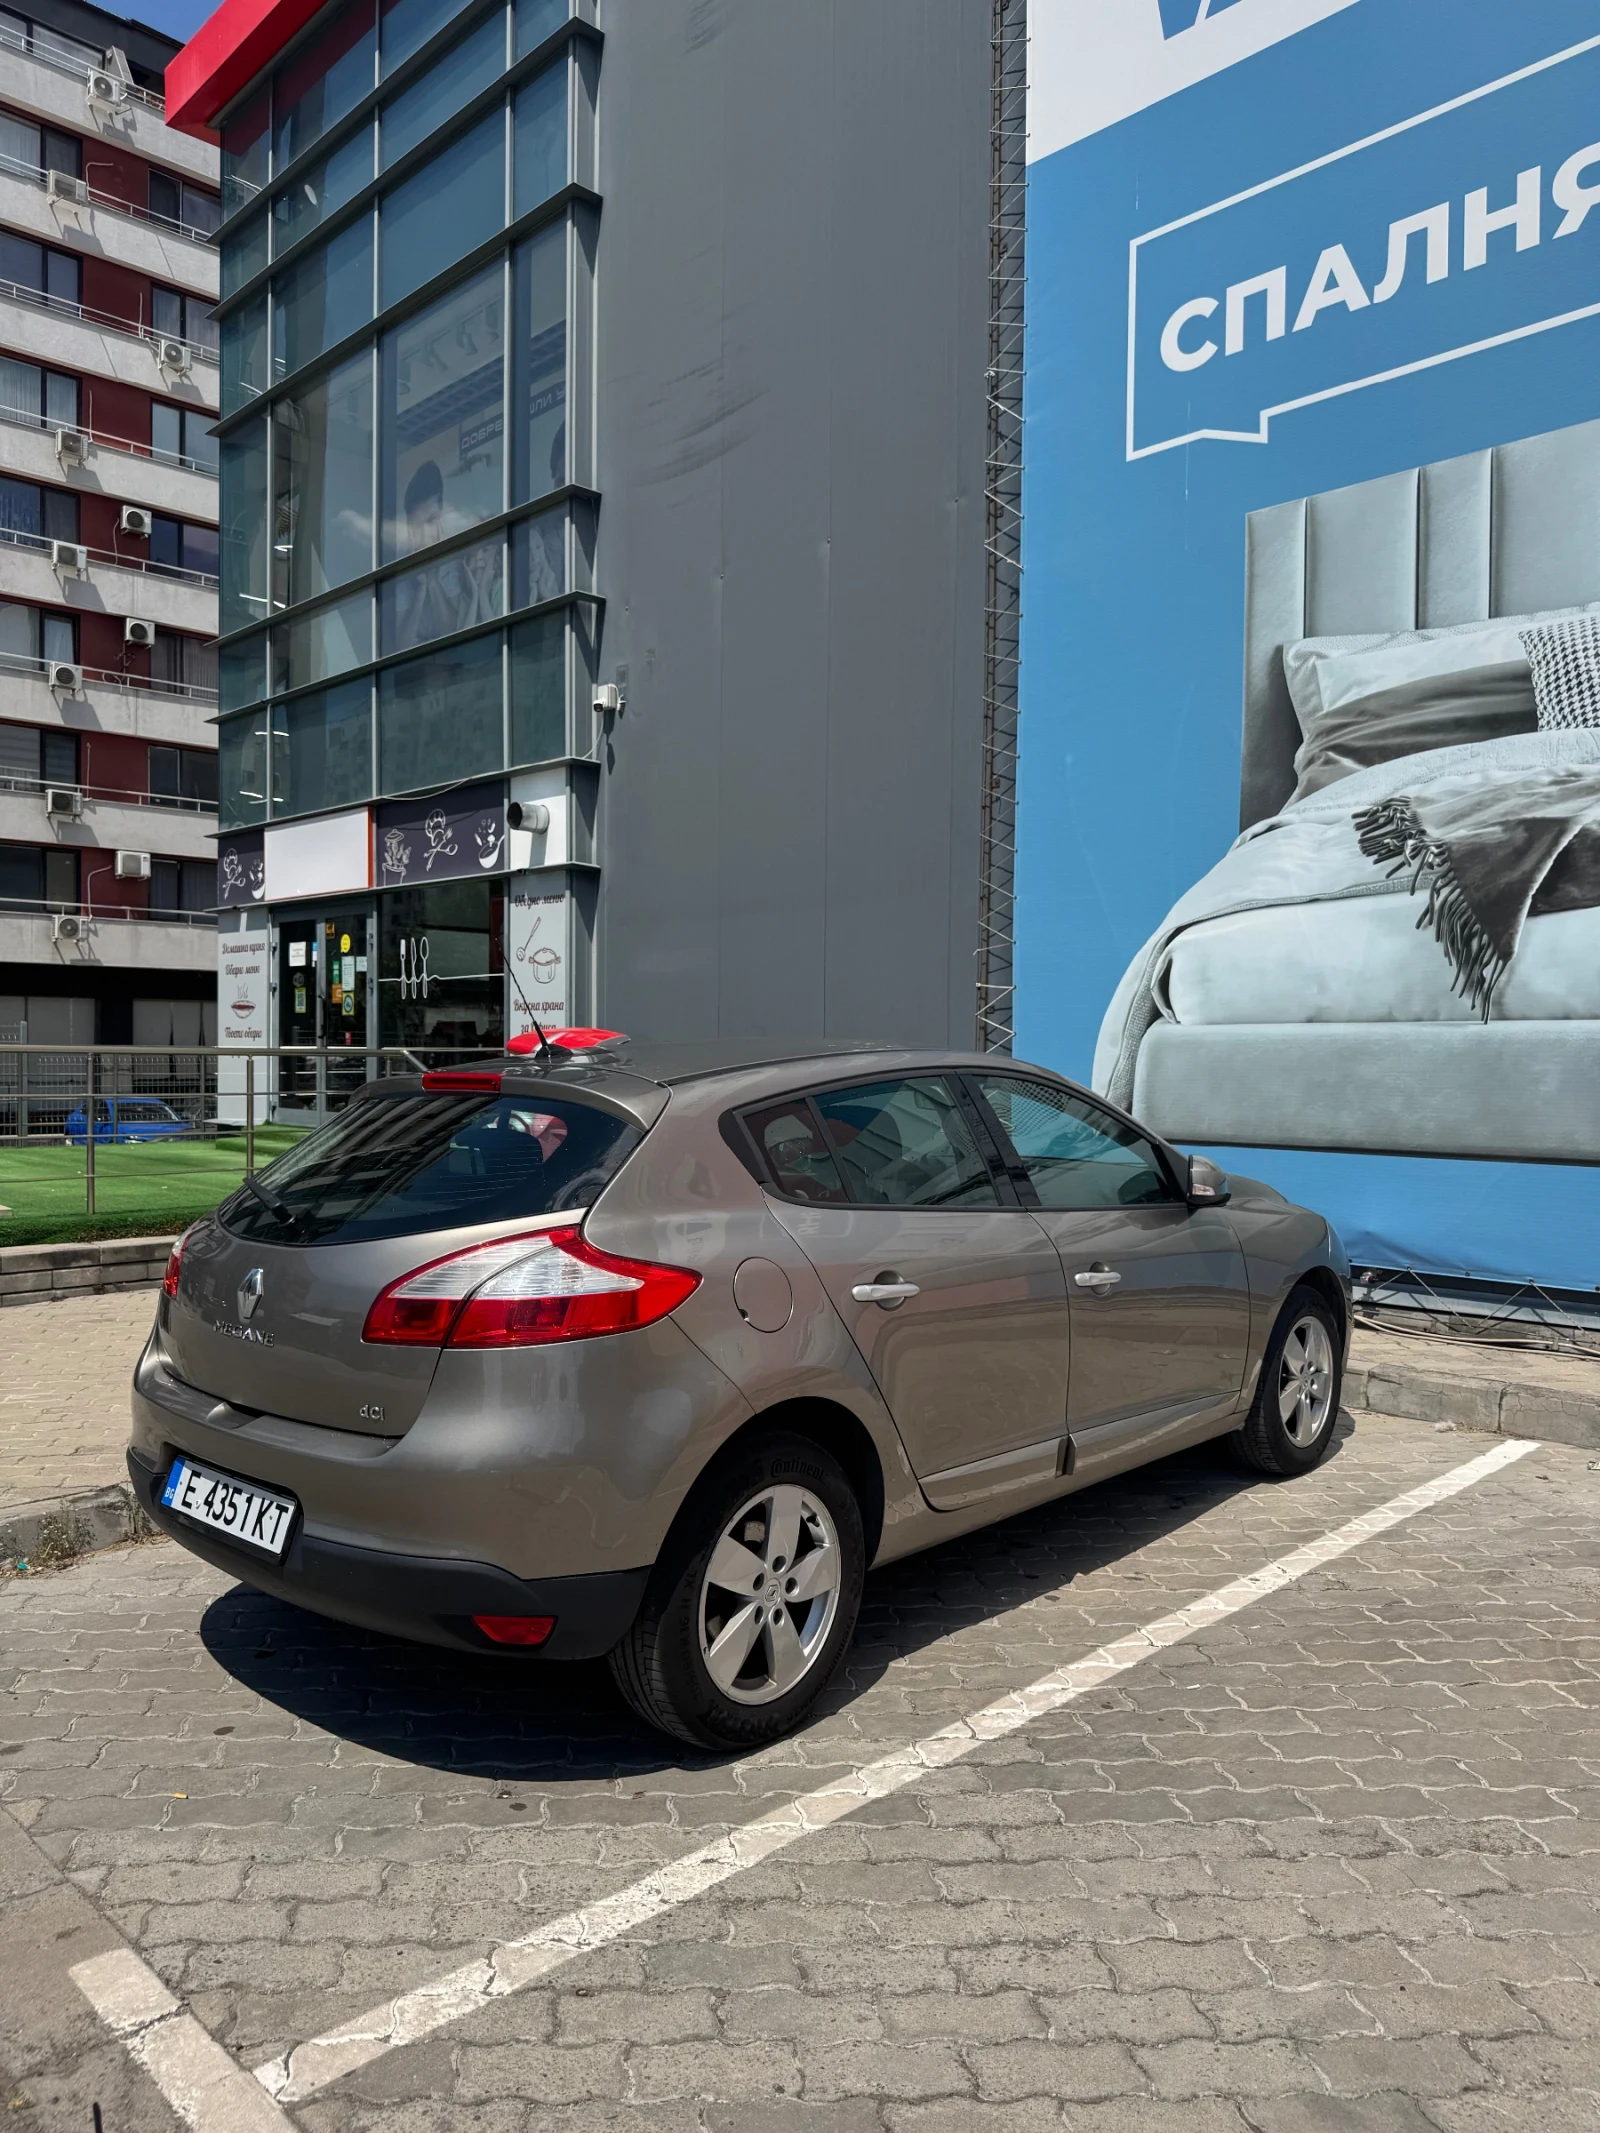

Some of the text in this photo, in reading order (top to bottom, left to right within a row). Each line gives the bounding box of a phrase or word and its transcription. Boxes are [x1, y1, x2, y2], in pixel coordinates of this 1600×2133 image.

[1160, 142, 1600, 373] СПАЛНЯ
[542, 893, 565, 905] меню
[541, 1001, 564, 1015] храна
[213, 1319, 275, 1347] MEGANE
[164, 1486, 175, 1499] BG
